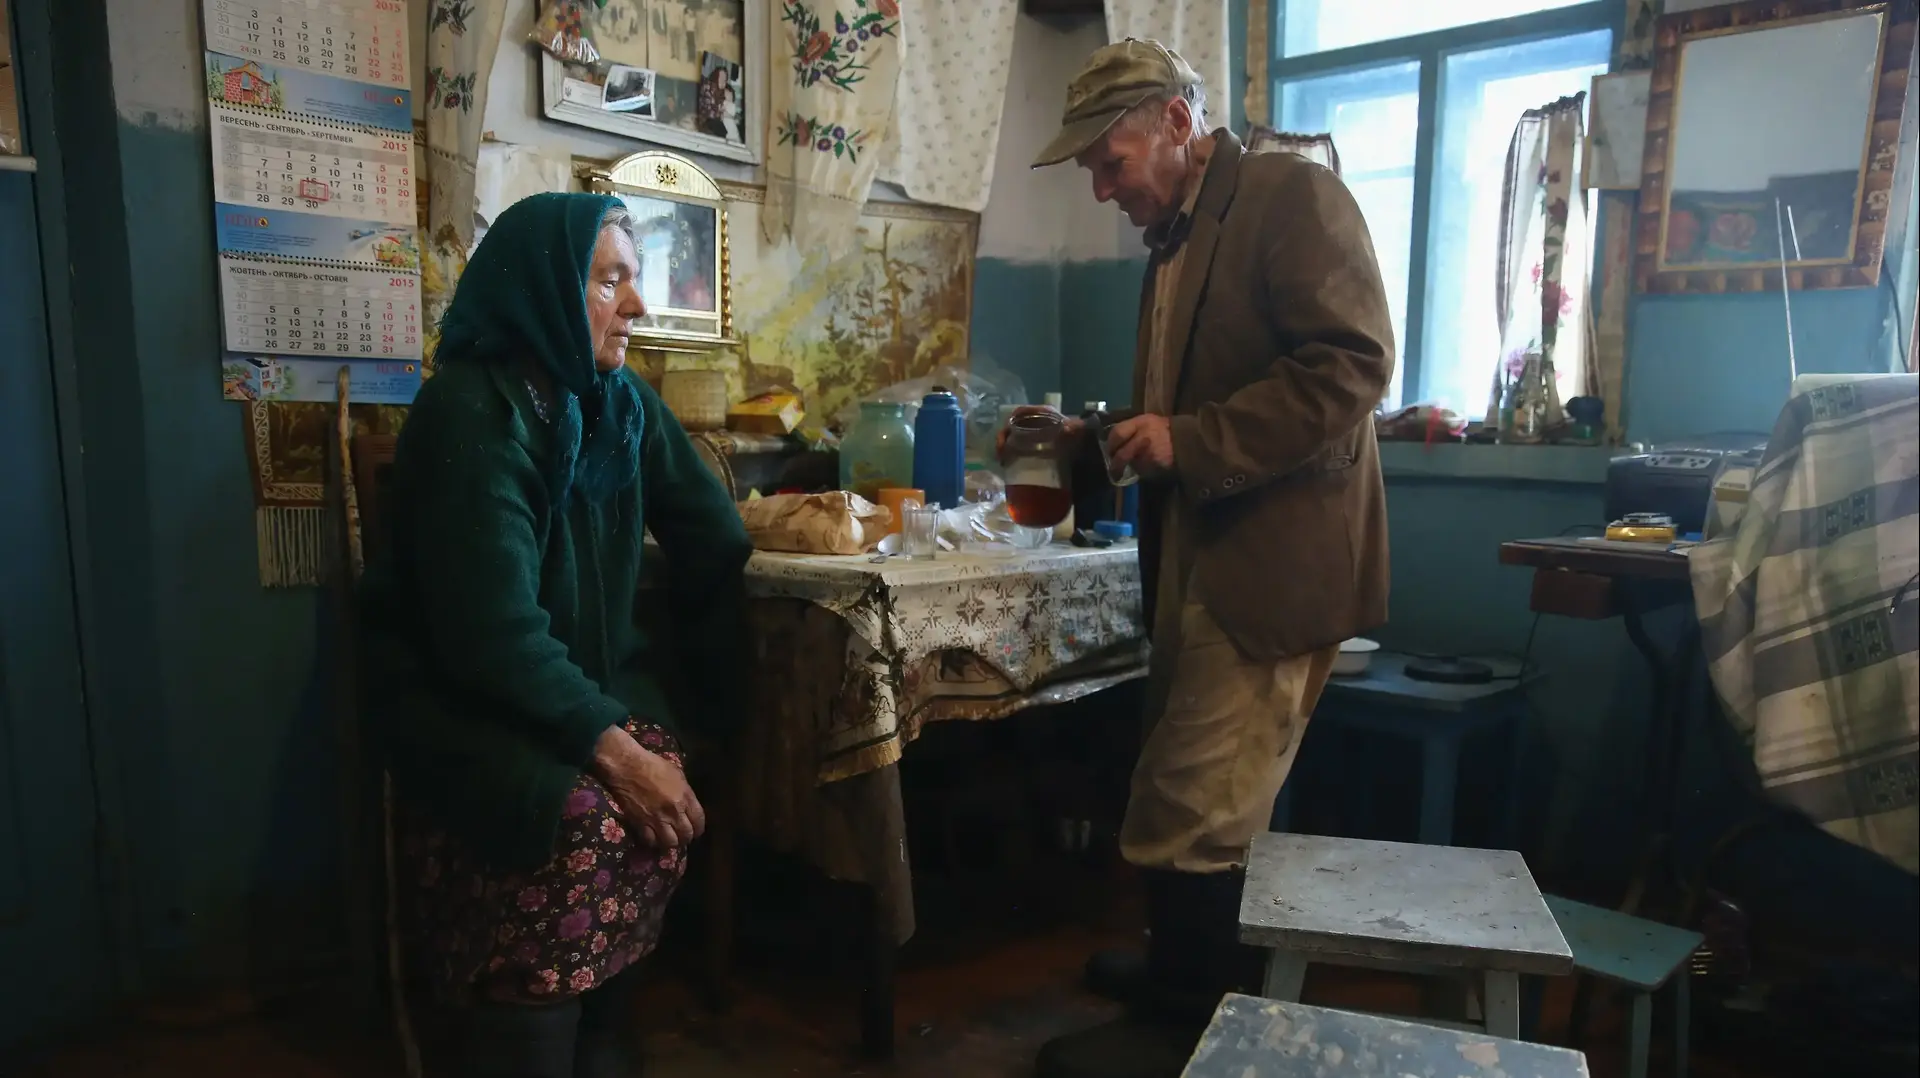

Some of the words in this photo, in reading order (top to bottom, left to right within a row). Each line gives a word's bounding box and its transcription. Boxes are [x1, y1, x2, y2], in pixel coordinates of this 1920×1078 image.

[376, 1, 400, 12] 2015
[251, 9, 258, 18] 3
[276, 16, 283, 24] 4
[301, 21, 308, 29] 5
[326, 27, 332, 35] 6
[350, 31, 355, 39] 7
[246, 21, 259, 30] 10
[272, 26, 282, 36] 11
[297, 32, 308, 41] 12
[321, 38, 332, 46] 13
[345, 43, 356, 51] 14
[369, 48, 379, 56] 15
[248, 33, 260, 42] 17
[273, 39, 285, 48] 18
[298, 44, 309, 53] 19
[321, 49, 333, 58] 20
[345, 54, 355, 62] 21
[368, 59, 380, 67] 22
[273, 50, 286, 60] 25
[297, 56, 310, 65] 26
[322, 61, 333, 69] 27
[345, 66, 357, 74] 28
[369, 70, 380, 78] 29
[392, 74, 403, 83] 30
[220, 115, 260, 128] ВЕРЕСЕНЬ
[266, 124, 306, 136] СЕНТЯБРЬ
[311, 131, 353, 143] SEPTEMBER
[382, 140, 407, 152] 2015
[310, 154, 316, 162] 2
[261, 158, 267, 167] 7
[286, 162, 292, 170] 8
[329, 169, 340, 177] 10
[376, 174, 386, 184] 12
[398, 178, 408, 186] 13
[256, 170, 268, 179] 14
[282, 174, 293, 182] 15
[397, 189, 409, 197] 20
[256, 182, 268, 192] 21
[257, 194, 269, 203] 28
[282, 197, 294, 205] 29
[306, 200, 318, 208] 30
[230, 266, 267, 276] ЖОВТЕНЬ
[273, 270, 308, 280] ОКТЯБРЬ
[314, 274, 348, 282] OCTOBER
[389, 277, 414, 288] 2015
[270, 305, 276, 314] 5
[293, 307, 300, 315] 6
[364, 301, 370, 309] 2
[264, 317, 276, 326] 12
[289, 318, 300, 326] 13
[313, 320, 325, 328] 14
[337, 321, 348, 330] 15
[265, 328, 277, 337] 19
[289, 330, 301, 338] 20
[313, 331, 324, 339] 21
[336, 332, 348, 340] 22
[360, 333, 371, 342] 23
[382, 335, 394, 343] 24
[405, 336, 416, 344] 25
[265, 340, 277, 348] 26
[289, 341, 301, 349] 27
[313, 342, 326, 350] 28
[337, 344, 348, 352] 29
